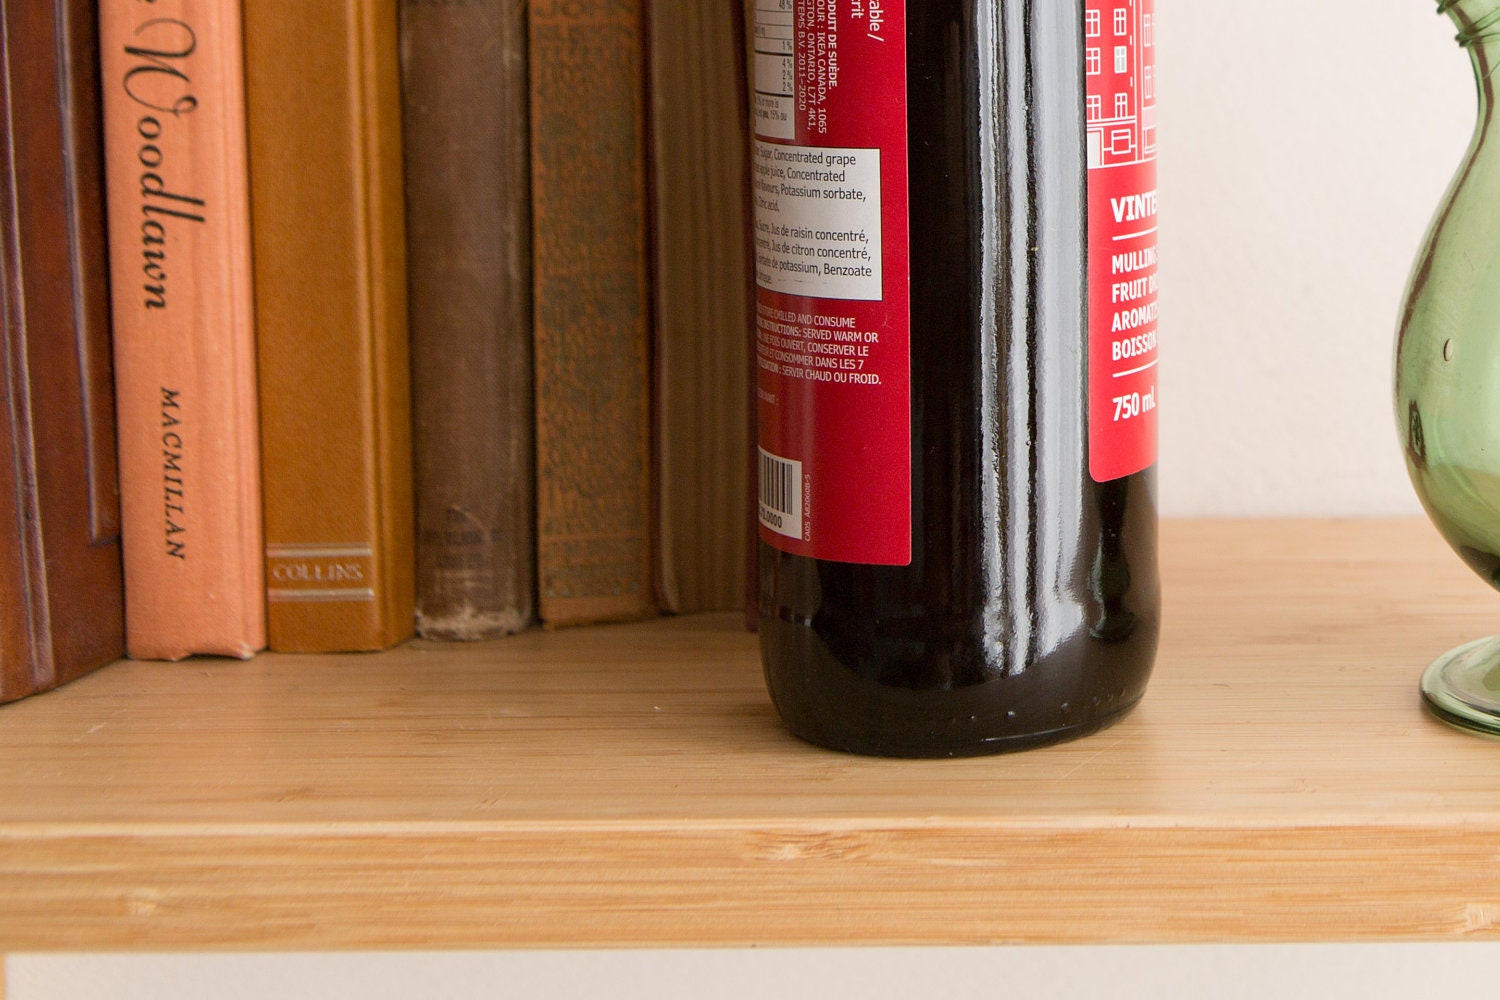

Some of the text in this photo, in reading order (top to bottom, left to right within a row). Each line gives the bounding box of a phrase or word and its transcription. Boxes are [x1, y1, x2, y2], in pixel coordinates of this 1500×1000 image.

[798, 31, 806, 49] B.V.
[817, 32, 826, 57] IKEA
[828, 34, 837, 49] DE
[867, 33, 884, 42] /
[807, 33, 816, 83] ONTARIO,
[828, 51, 840, 90] SUÈDE.
[817, 60, 827, 104] CANADA,
[808, 87, 817, 105] L7T
[807, 107, 817, 130] 4K1,
[818, 107, 827, 134] 1065
[123, 17, 206, 310] Woodlawn
[774, 148, 823, 164] Concentrated
[825, 154, 856, 167] grape
[786, 167, 845, 182] Concentrated
[780, 183, 821, 199] Potassium
[823, 187, 866, 202] sorbate,
[780, 224, 789, 237] de
[790, 226, 813, 240] raisin
[815, 229, 869, 244] concentré,
[781, 241, 790, 254] de
[791, 243, 815, 257] citron
[817, 245, 871, 261] concentré,
[779, 260, 822, 277] potassium,
[824, 263, 872, 277] Benzoate
[1111, 276, 1148, 304] FRUIT
[774, 309, 796, 323] CHILLED
[797, 313, 812, 325] AND
[814, 316, 855, 329] CONSUME
[803, 328, 831, 341] SERVED
[833, 331, 862, 343] WARM
[864, 331, 879, 343] OR
[1111, 330, 1157, 361] BOISSON
[780, 338, 806, 353] OUVERT,
[807, 342, 855, 357] CONSERVER
[857, 345, 869, 357] LE
[775, 349, 813, 366] CONSOMMER
[815, 356, 837, 369] DANS
[839, 358, 856, 370] LES
[858, 359, 864, 370] 7
[782, 365, 804, 378] SERVIR
[805, 369, 831, 382] CHAUD
[833, 371, 847, 383] OU
[849, 372, 882, 385] FROID.
[1112, 385, 1157, 422] 750 mL
[160, 386, 186, 561] MACMILLAN
[272, 563, 364, 582] COLLINS
